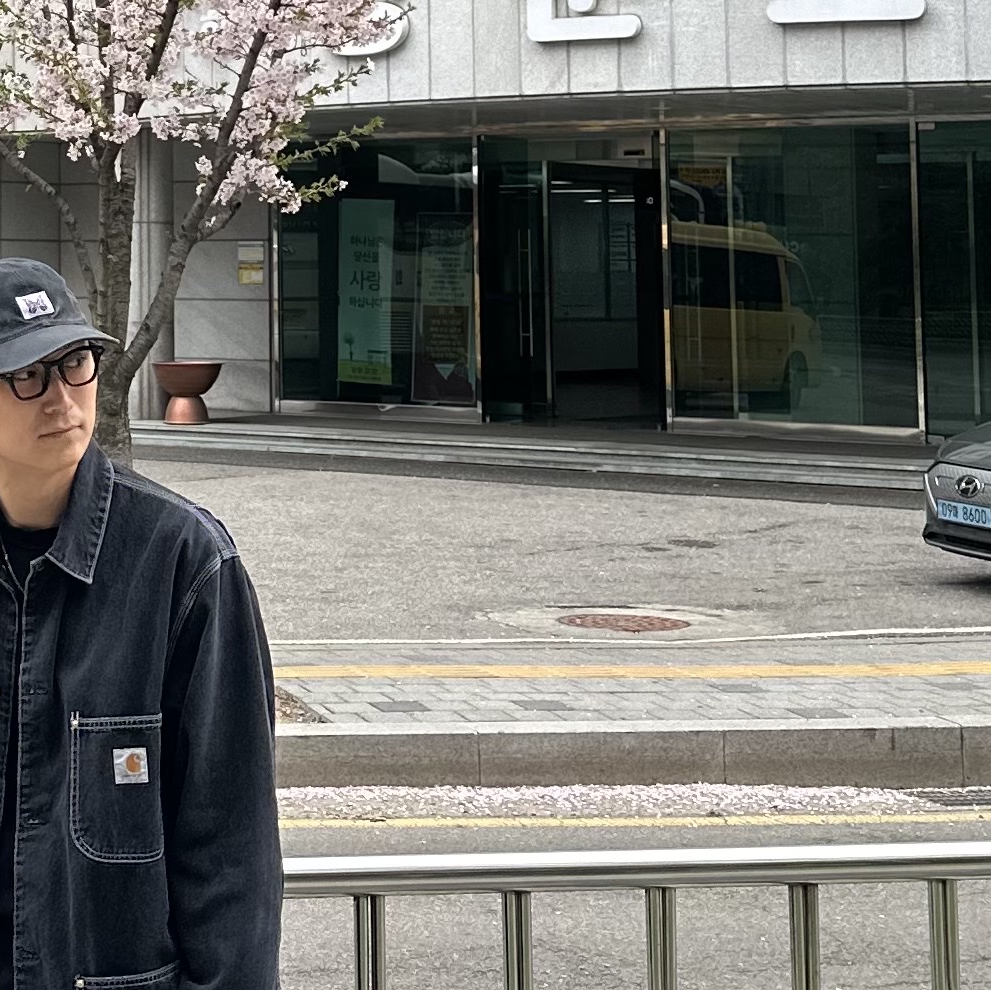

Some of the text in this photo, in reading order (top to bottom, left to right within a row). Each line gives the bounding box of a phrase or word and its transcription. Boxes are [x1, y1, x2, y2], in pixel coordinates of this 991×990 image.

[349, 270, 382, 291] 사랑
[349, 295, 383, 308] 하십니다
[962, 505, 987, 525] 8600
